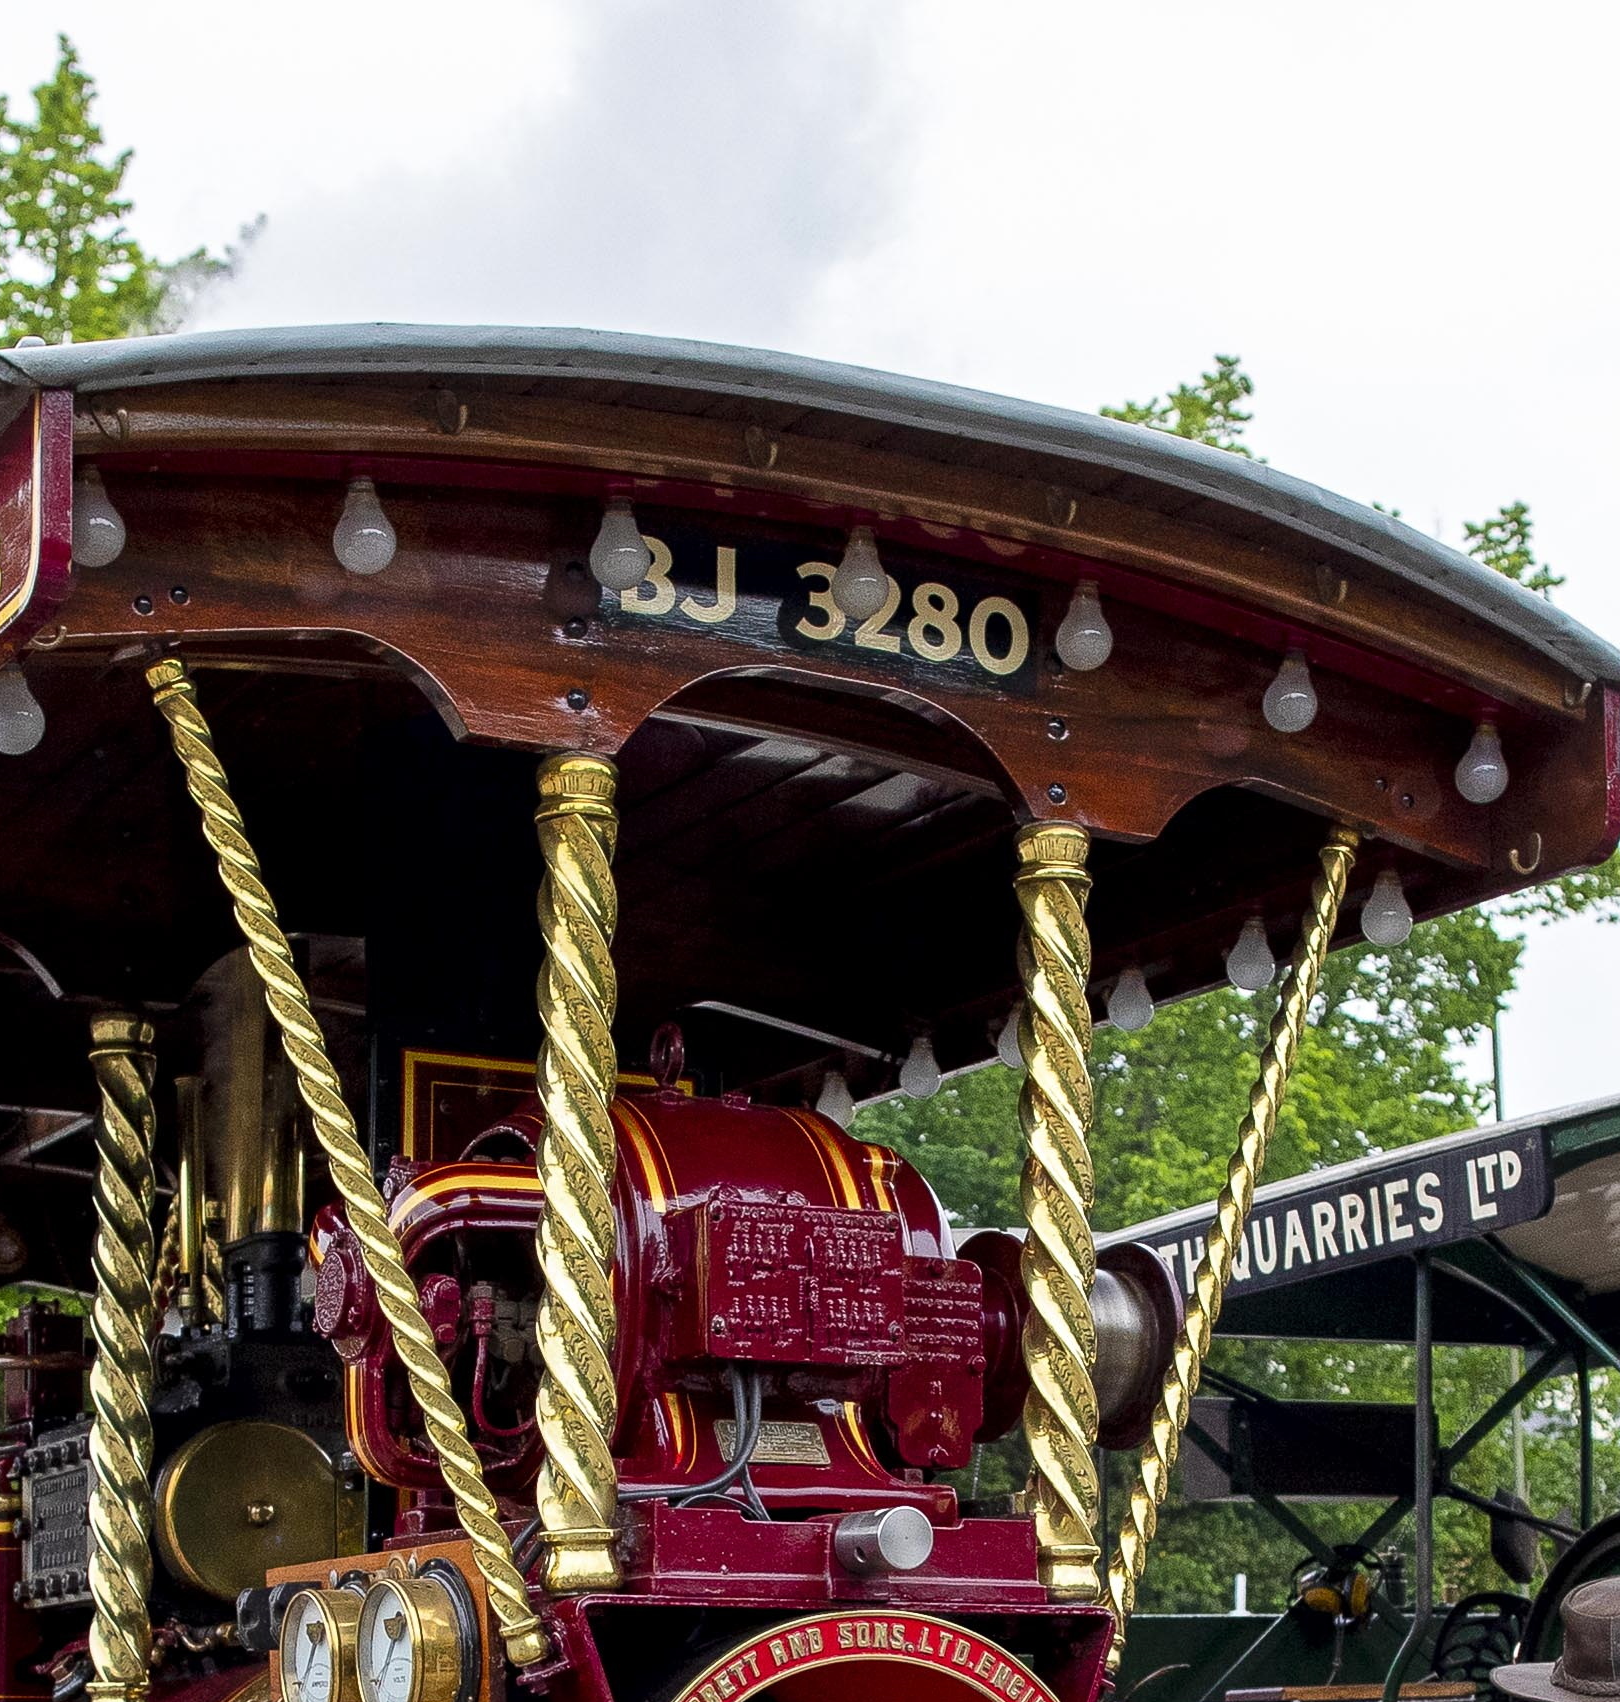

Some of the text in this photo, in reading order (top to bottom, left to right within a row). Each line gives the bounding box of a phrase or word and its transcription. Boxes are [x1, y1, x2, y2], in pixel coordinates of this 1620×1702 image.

[620, 535, 1030, 676] BJ 3280
[768, 1628, 823, 1668] AND
